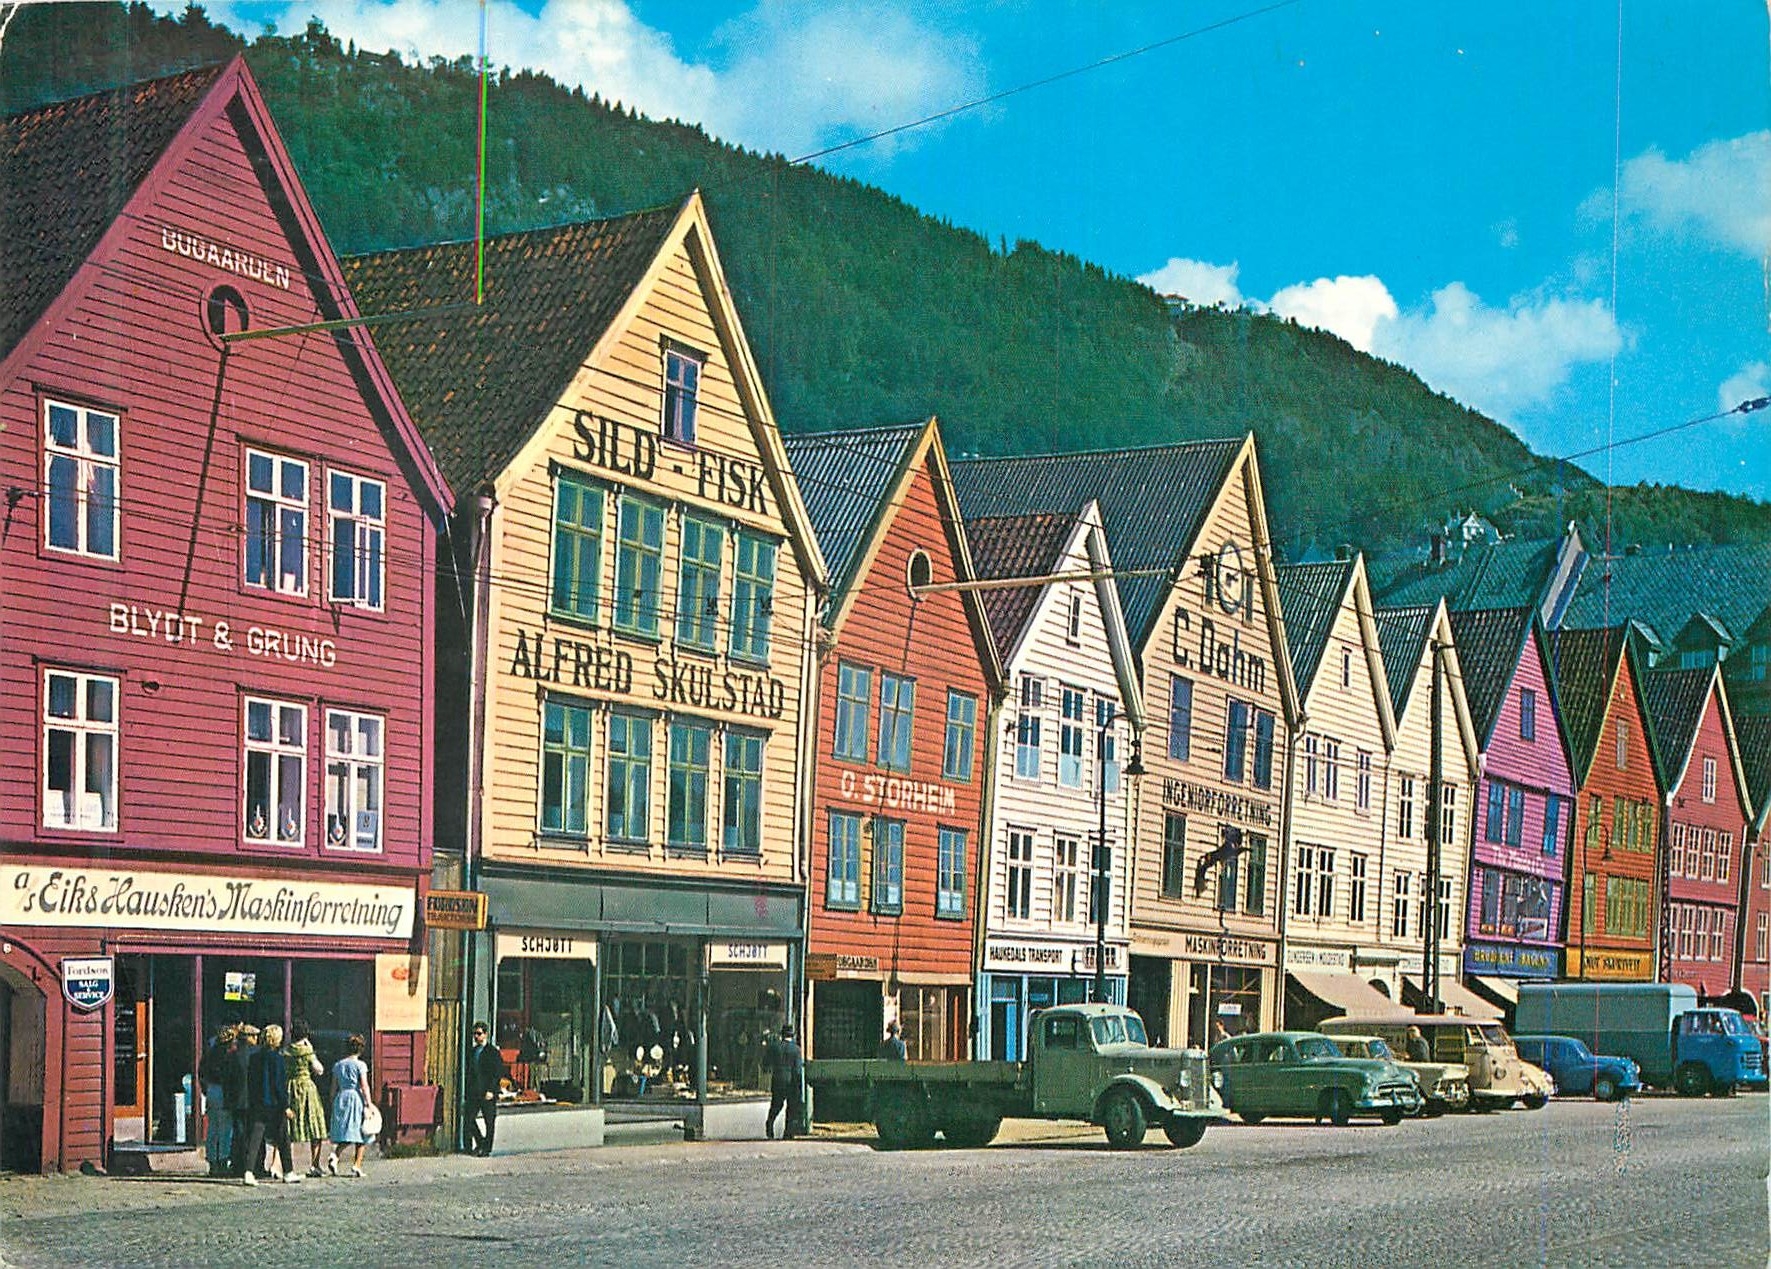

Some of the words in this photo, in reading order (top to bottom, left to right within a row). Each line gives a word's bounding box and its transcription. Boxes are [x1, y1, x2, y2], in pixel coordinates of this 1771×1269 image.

[573, 409, 655, 481] SILD
[698, 449, 769, 515] FISK
[109, 603, 203, 645] BLYDT
[213, 621, 233, 651] &
[247, 626, 337, 668] GRUNG
[1173, 605, 1193, 671] C.
[1200, 616, 1265, 694] Dahm
[510, 629, 633, 695] ALFRED
[652, 656, 785, 720] SKULSTAD
[39, 871, 86, 914] Eik
[216, 882, 404, 935] Maskinforretning
[67, 965, 109, 976] Fordson
